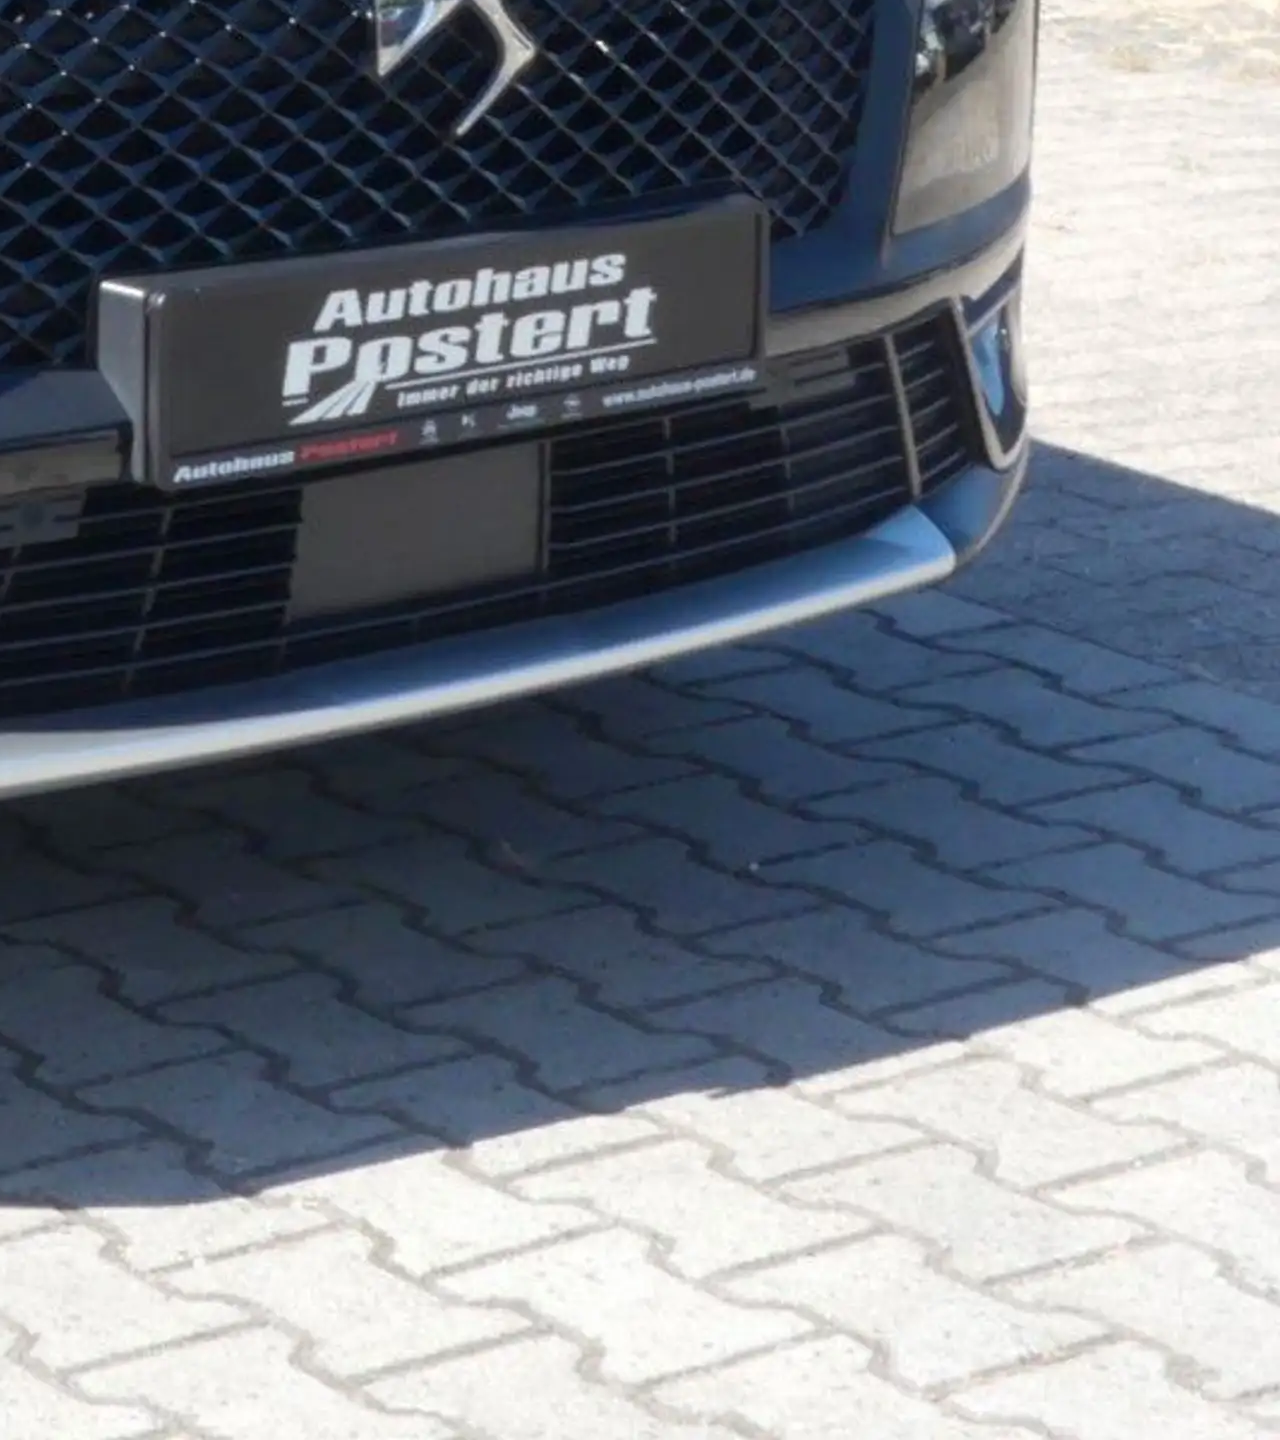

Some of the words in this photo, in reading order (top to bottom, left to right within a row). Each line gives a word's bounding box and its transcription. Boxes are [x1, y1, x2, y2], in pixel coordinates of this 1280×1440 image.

[313, 253, 627, 332] Autohaus
[282, 286, 658, 398] Postert
[505, 363, 583, 388] richtige
[173, 450, 296, 483] Autohaus
